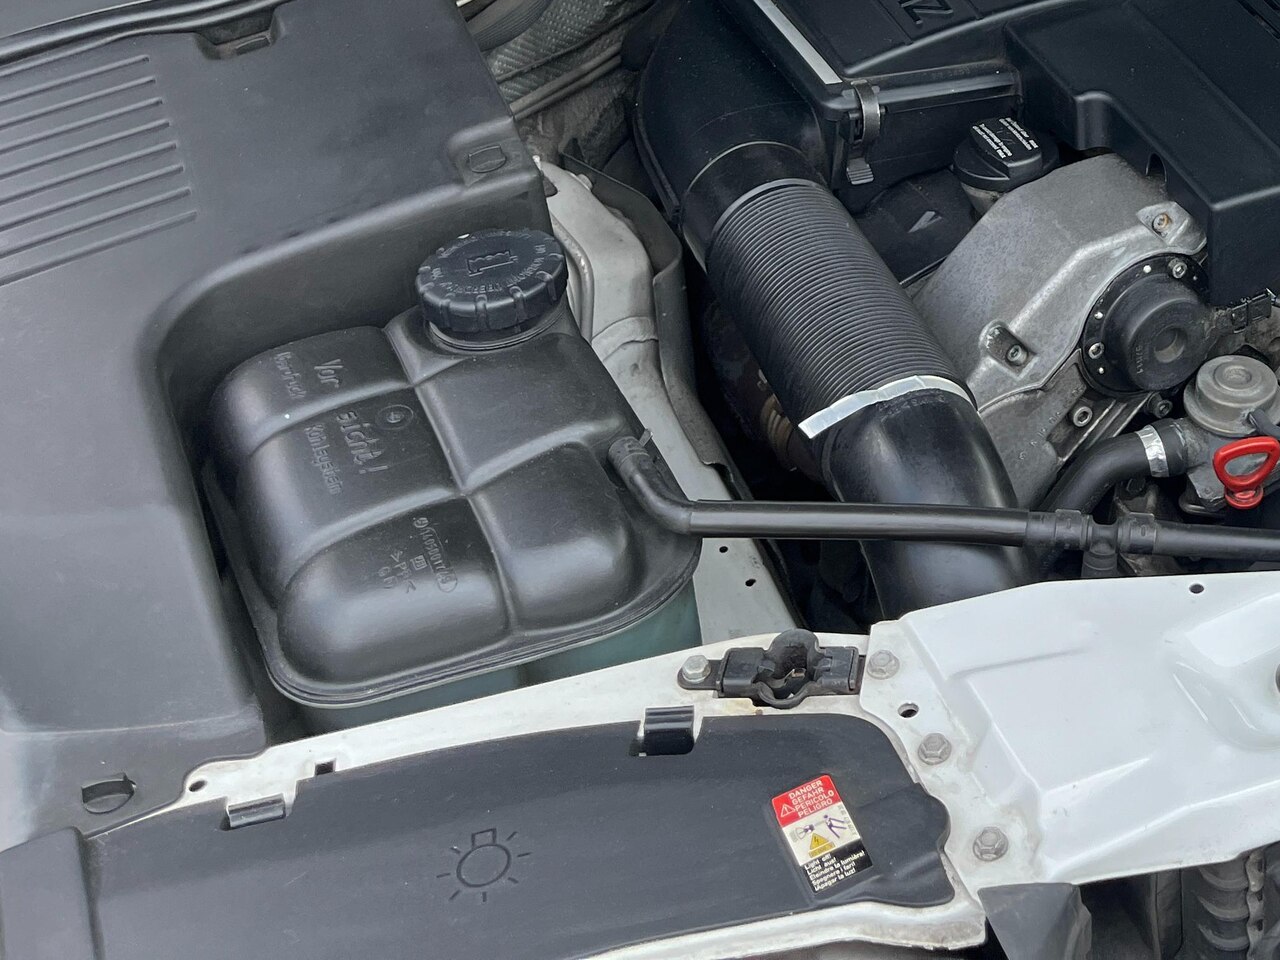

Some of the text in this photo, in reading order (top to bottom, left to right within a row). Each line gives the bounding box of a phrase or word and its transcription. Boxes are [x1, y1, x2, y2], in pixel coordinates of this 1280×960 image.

[788, 780, 823, 800] DANGER
[791, 787, 825, 806] GEFAHR
[795, 790, 835, 812] PERICOLO
[798, 798, 833, 818] PELIGRO
